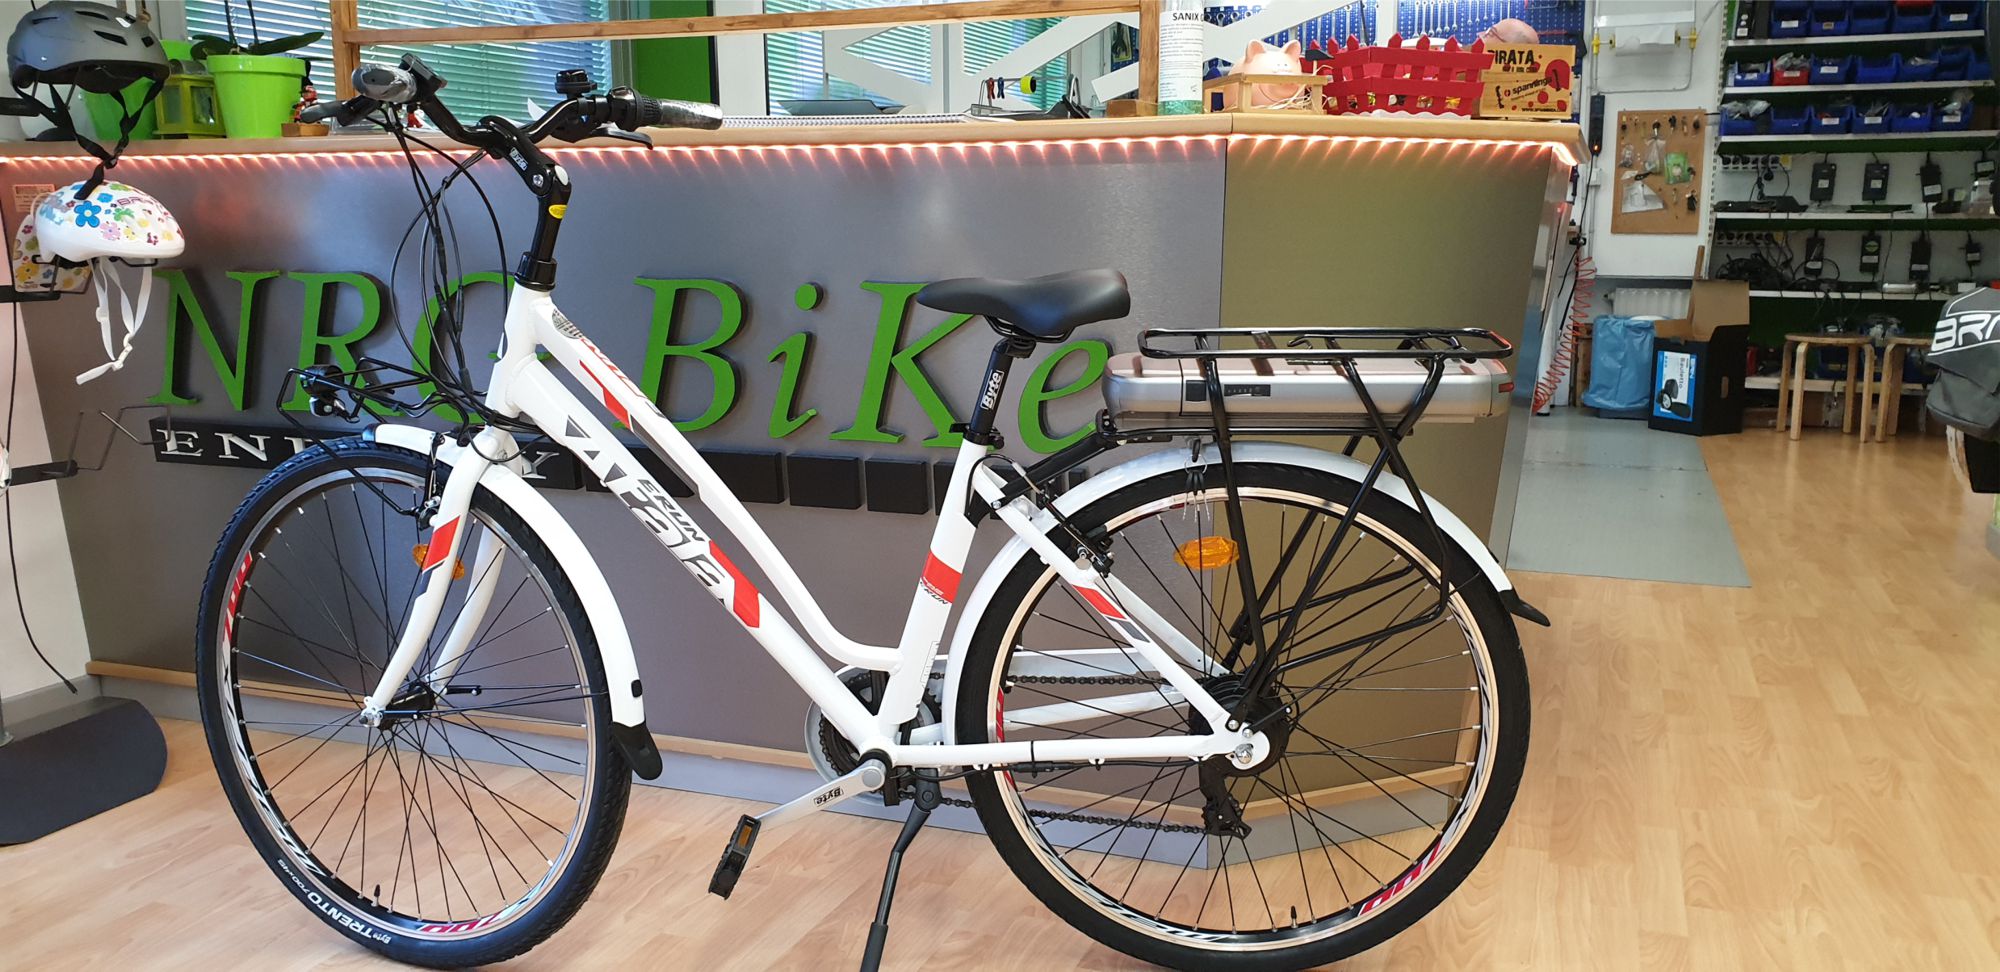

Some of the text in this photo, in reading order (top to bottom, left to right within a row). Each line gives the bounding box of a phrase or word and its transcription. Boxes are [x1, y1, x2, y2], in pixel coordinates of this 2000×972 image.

[1172, 12, 1199, 21] SANIX
[1487, 49, 1535, 64] IRATA
[148, 269, 1112, 454] NRG BiKe
[981, 371, 1001, 409] Byte
[816, 787, 842, 804] Byte
[306, 891, 374, 939] TRENTO
[371, 931, 392, 945] Byte
